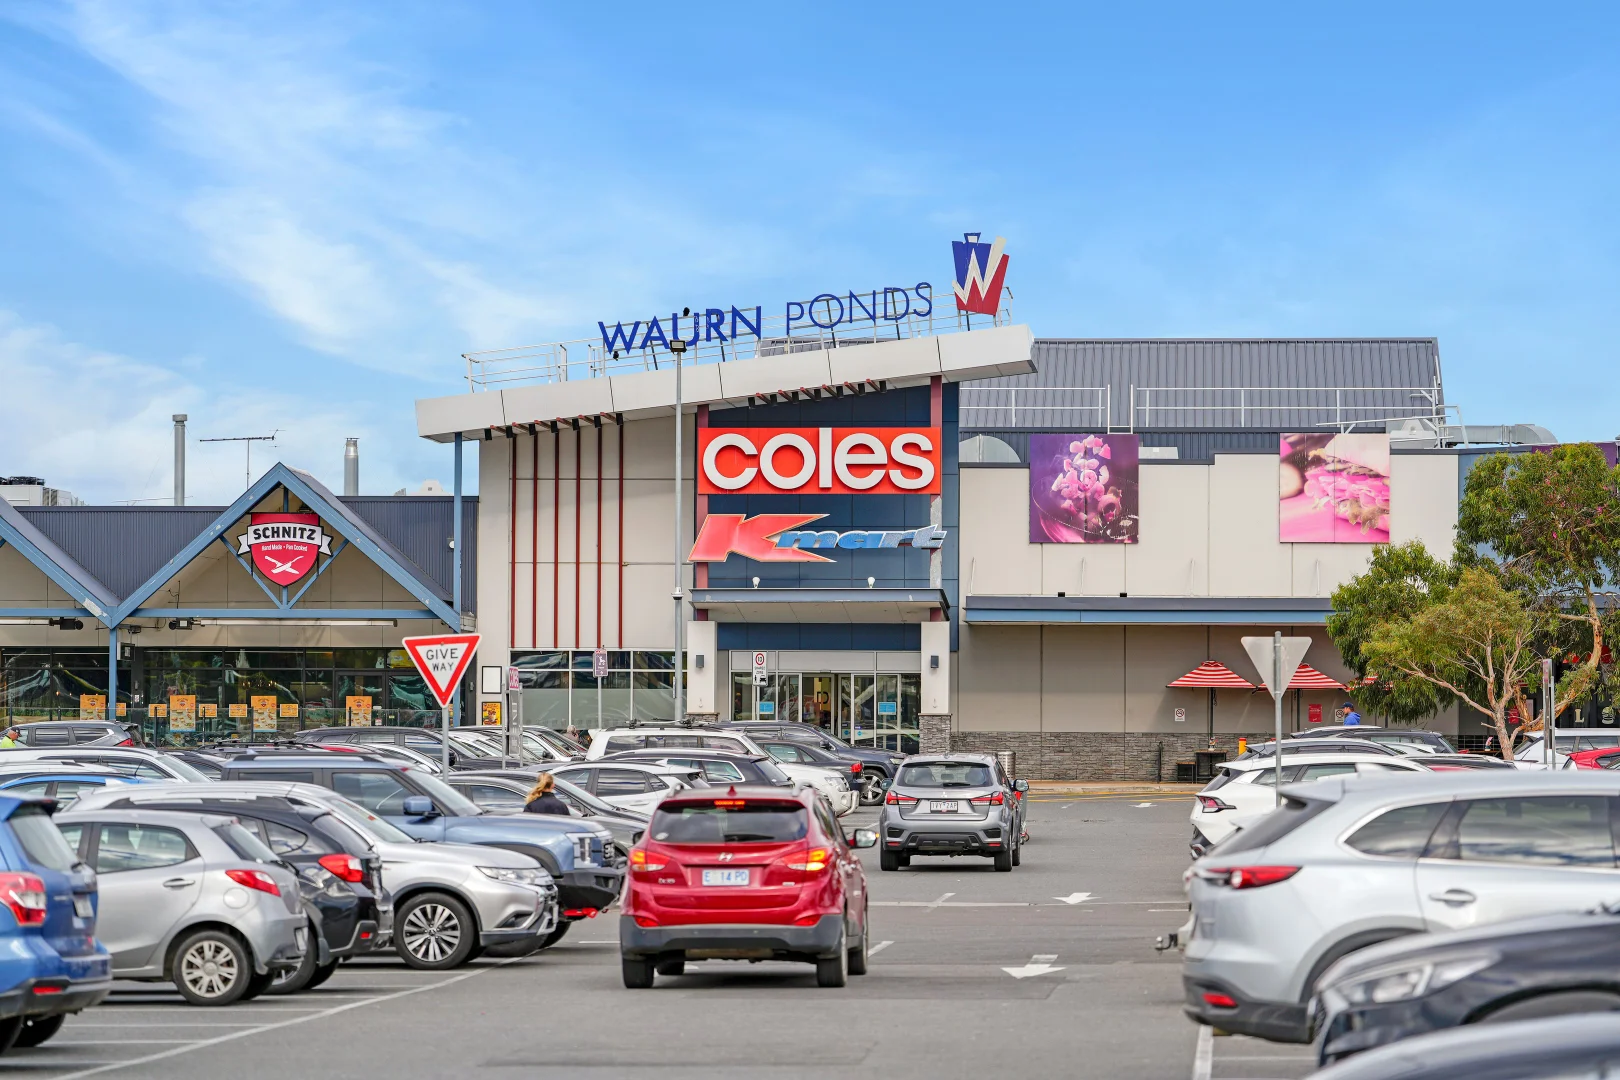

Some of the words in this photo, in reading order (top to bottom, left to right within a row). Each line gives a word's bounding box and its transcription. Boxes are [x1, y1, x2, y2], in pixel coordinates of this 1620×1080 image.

[597, 304, 762, 355] WAURN
[785, 281, 933, 335] PONDS
[702, 427, 935, 490] coles
[253, 527, 316, 540] SCHNITZ
[687, 513, 947, 562] Kmart
[426, 648, 459, 661] GIVE
[432, 662, 454, 671] WAY
